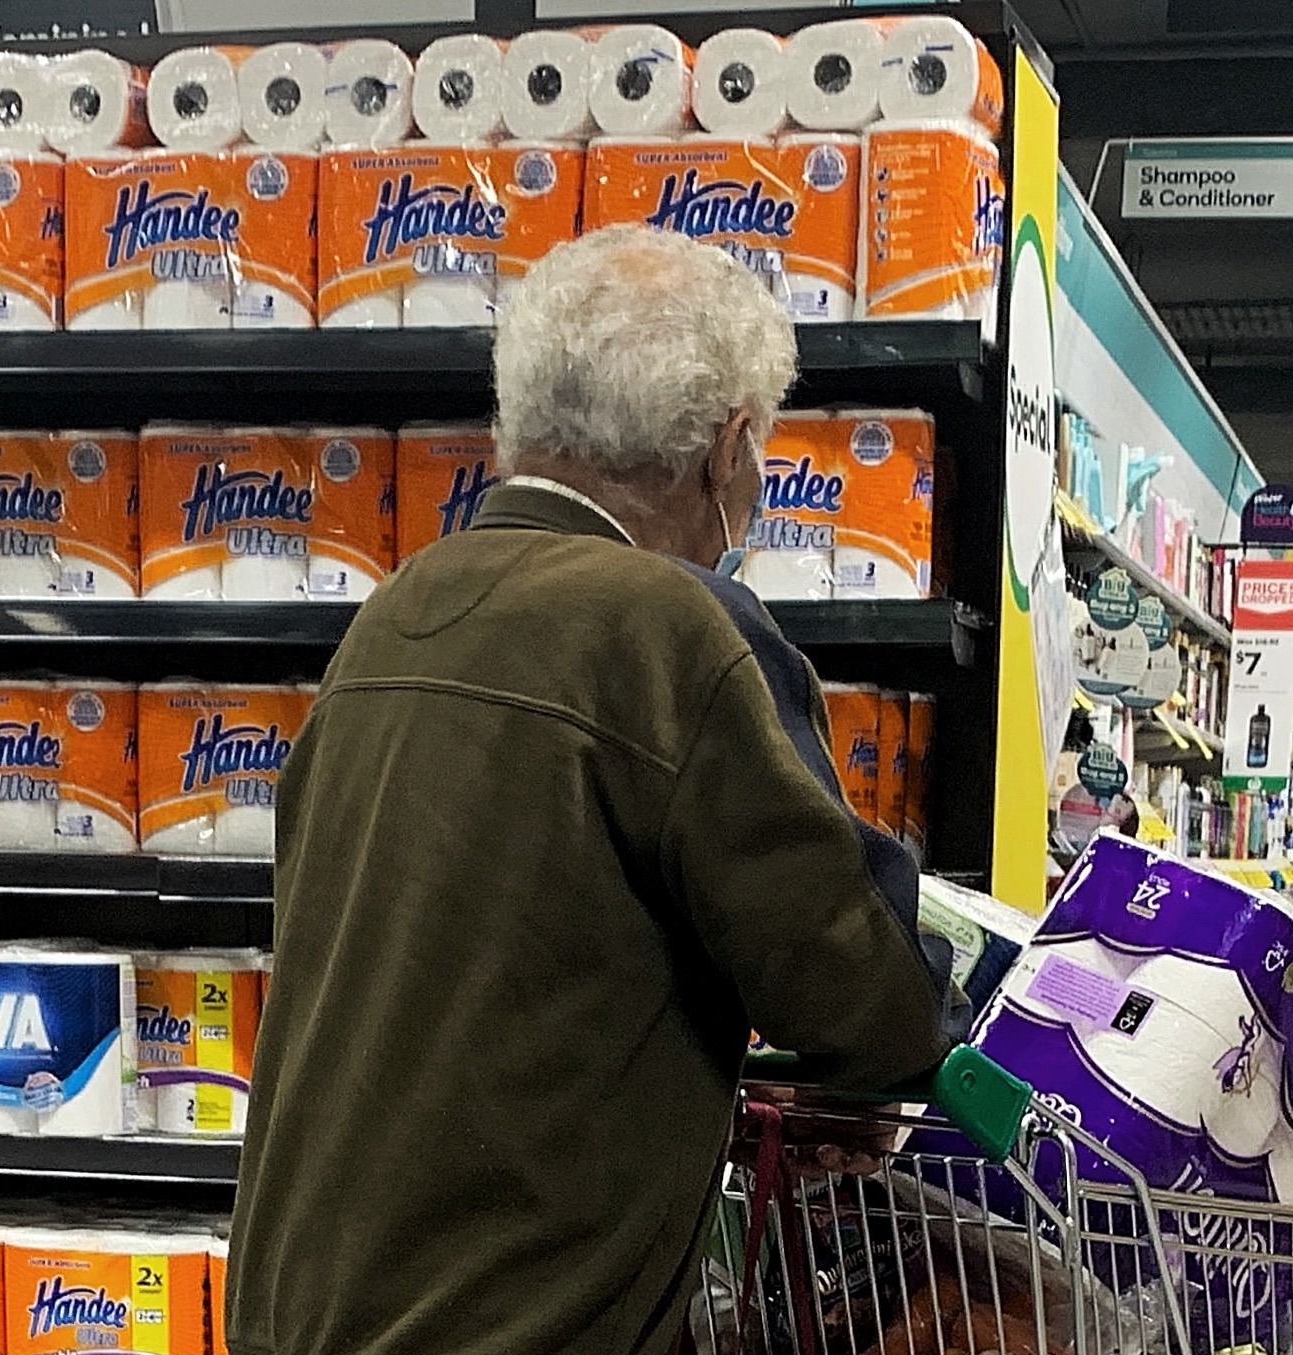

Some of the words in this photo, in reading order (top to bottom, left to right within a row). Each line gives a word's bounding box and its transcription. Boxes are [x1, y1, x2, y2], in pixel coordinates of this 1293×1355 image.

[647, 168, 795, 239] Handee
[1138, 191, 1154, 207] &
[1159, 188, 1276, 208] Conditioner
[1140, 166, 1237, 189] Shampoo
[106, 180, 240, 268] Handee
[365, 173, 507, 264] Handee
[1008, 366, 1053, 457] Special
[181, 459, 314, 542] Handee
[763, 456, 843, 512] ndee
[226, 527, 308, 557] Ultra
[1235, 651, 1262, 677] $7
[180, 713, 292, 792] Hande
[137, 1004, 192, 1045] ndee
[27, 1275, 128, 1339] Handee
[136, 1267, 164, 1287] 2x
